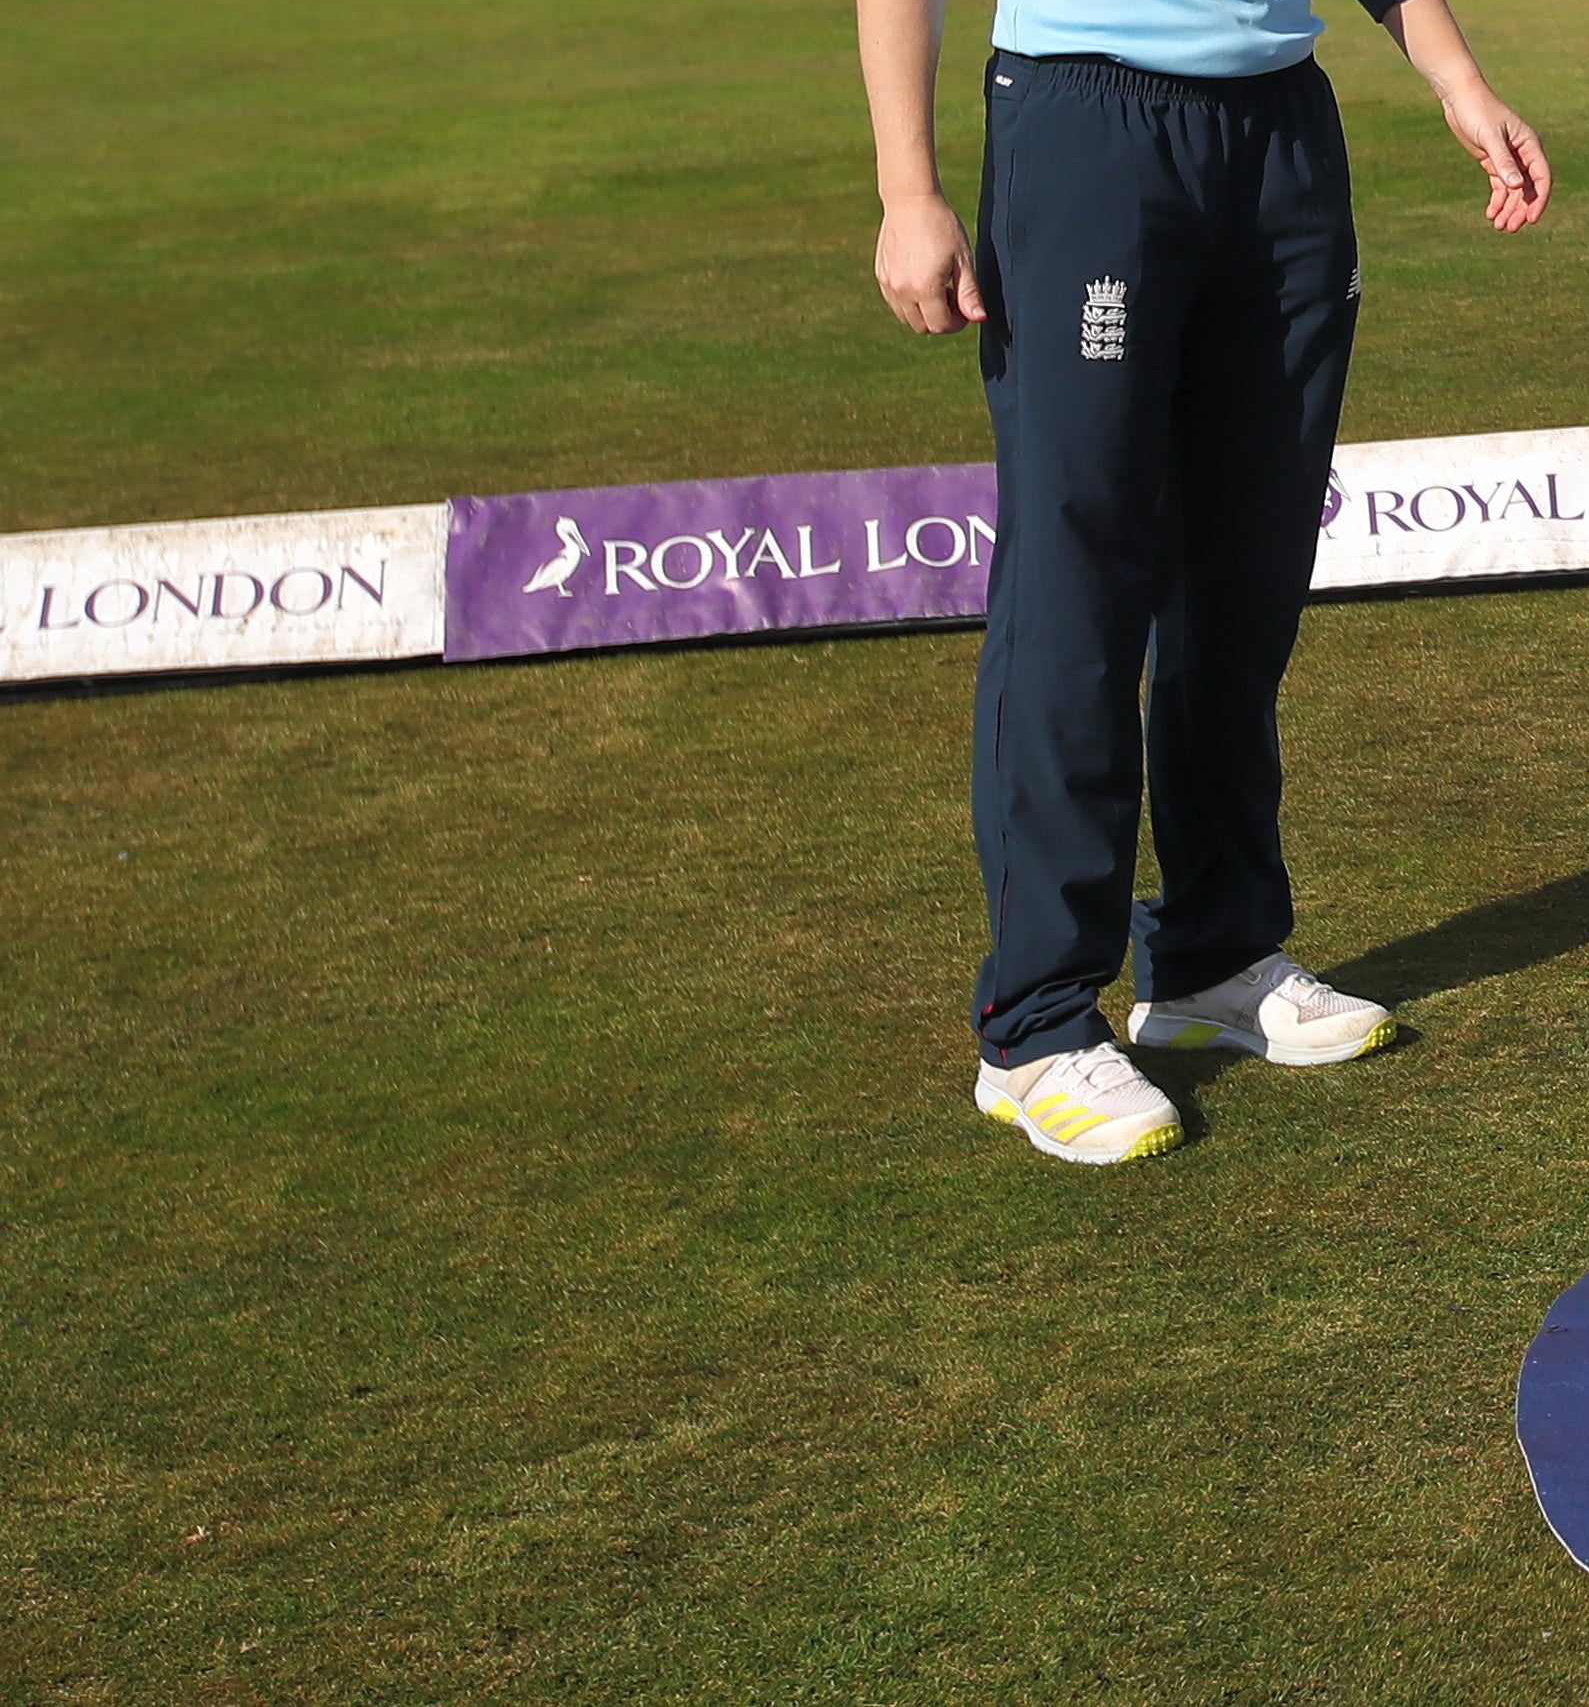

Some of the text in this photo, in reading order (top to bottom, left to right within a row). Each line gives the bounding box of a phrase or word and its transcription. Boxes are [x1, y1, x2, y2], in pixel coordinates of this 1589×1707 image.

[1366, 472, 1585, 536] ROYAL
[603, 513, 998, 596] ROYAL LON
[38, 558, 387, 632] LONDON
